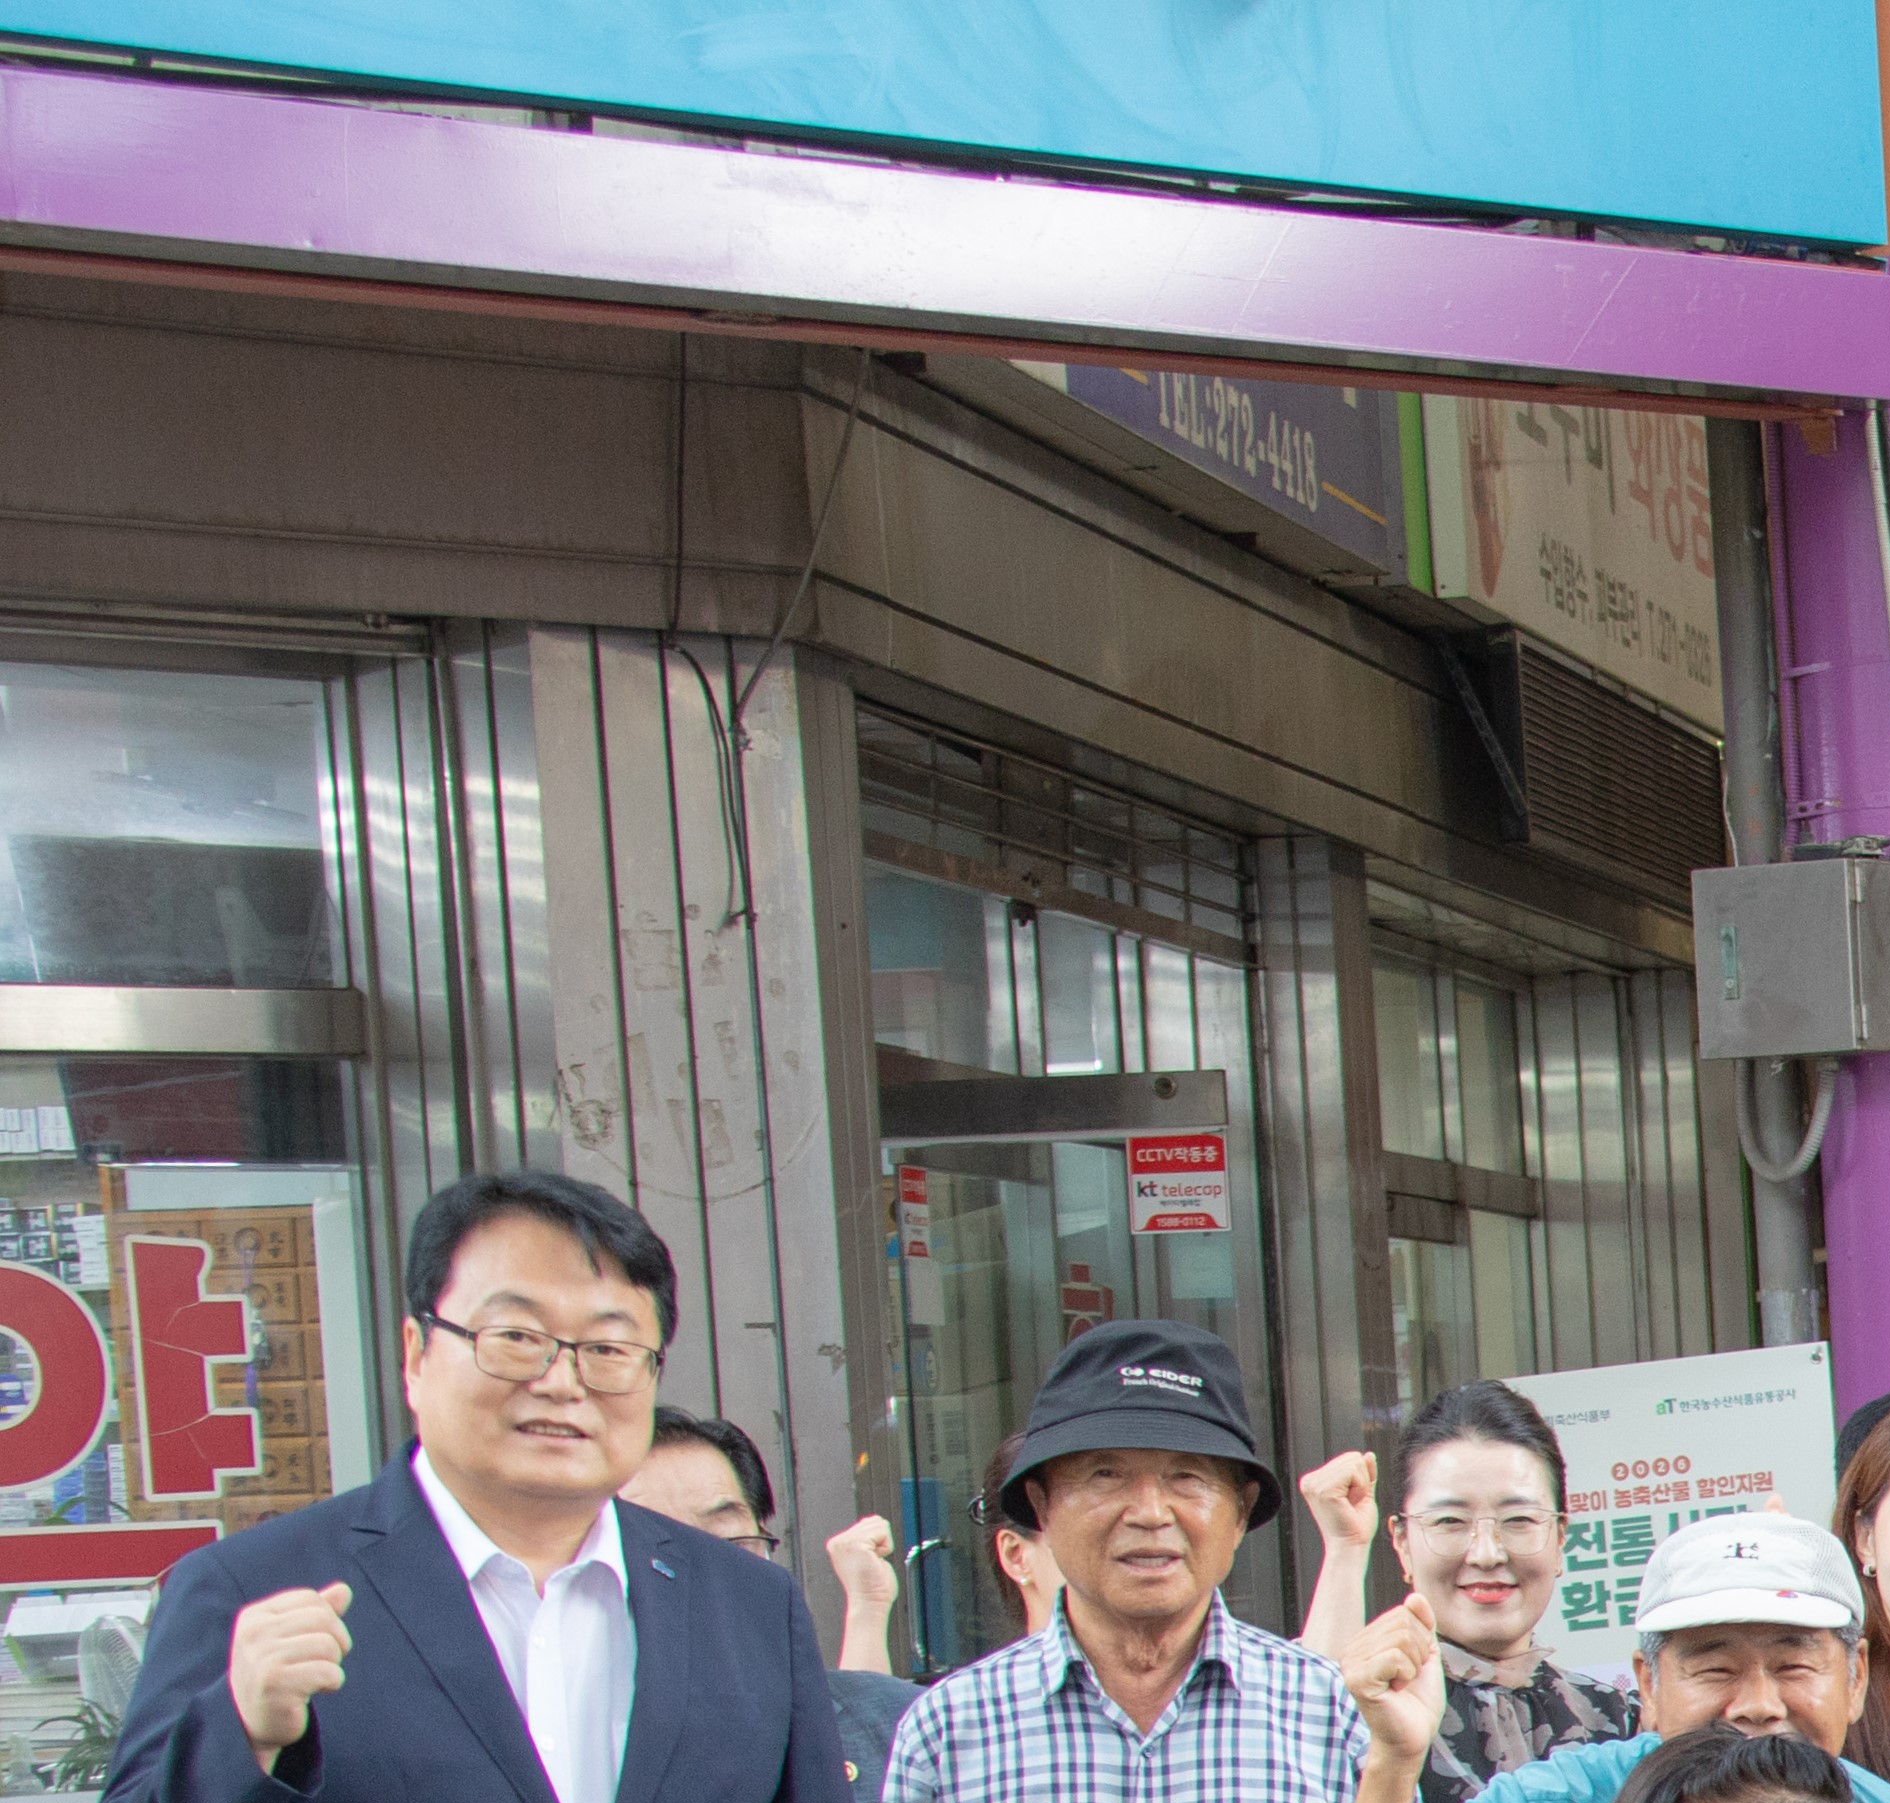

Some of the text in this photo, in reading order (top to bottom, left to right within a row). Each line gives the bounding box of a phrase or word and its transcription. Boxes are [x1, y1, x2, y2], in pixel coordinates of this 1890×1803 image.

[1136, 1146, 1217, 1163] CCTV작동중
[1137, 1181, 1222, 1199] kt telecop
[1656, 1387, 1797, 1415] aT 한국농수산식품유통공사
[1568, 1471, 1774, 1514] 맞이 농축산물 할인지원
